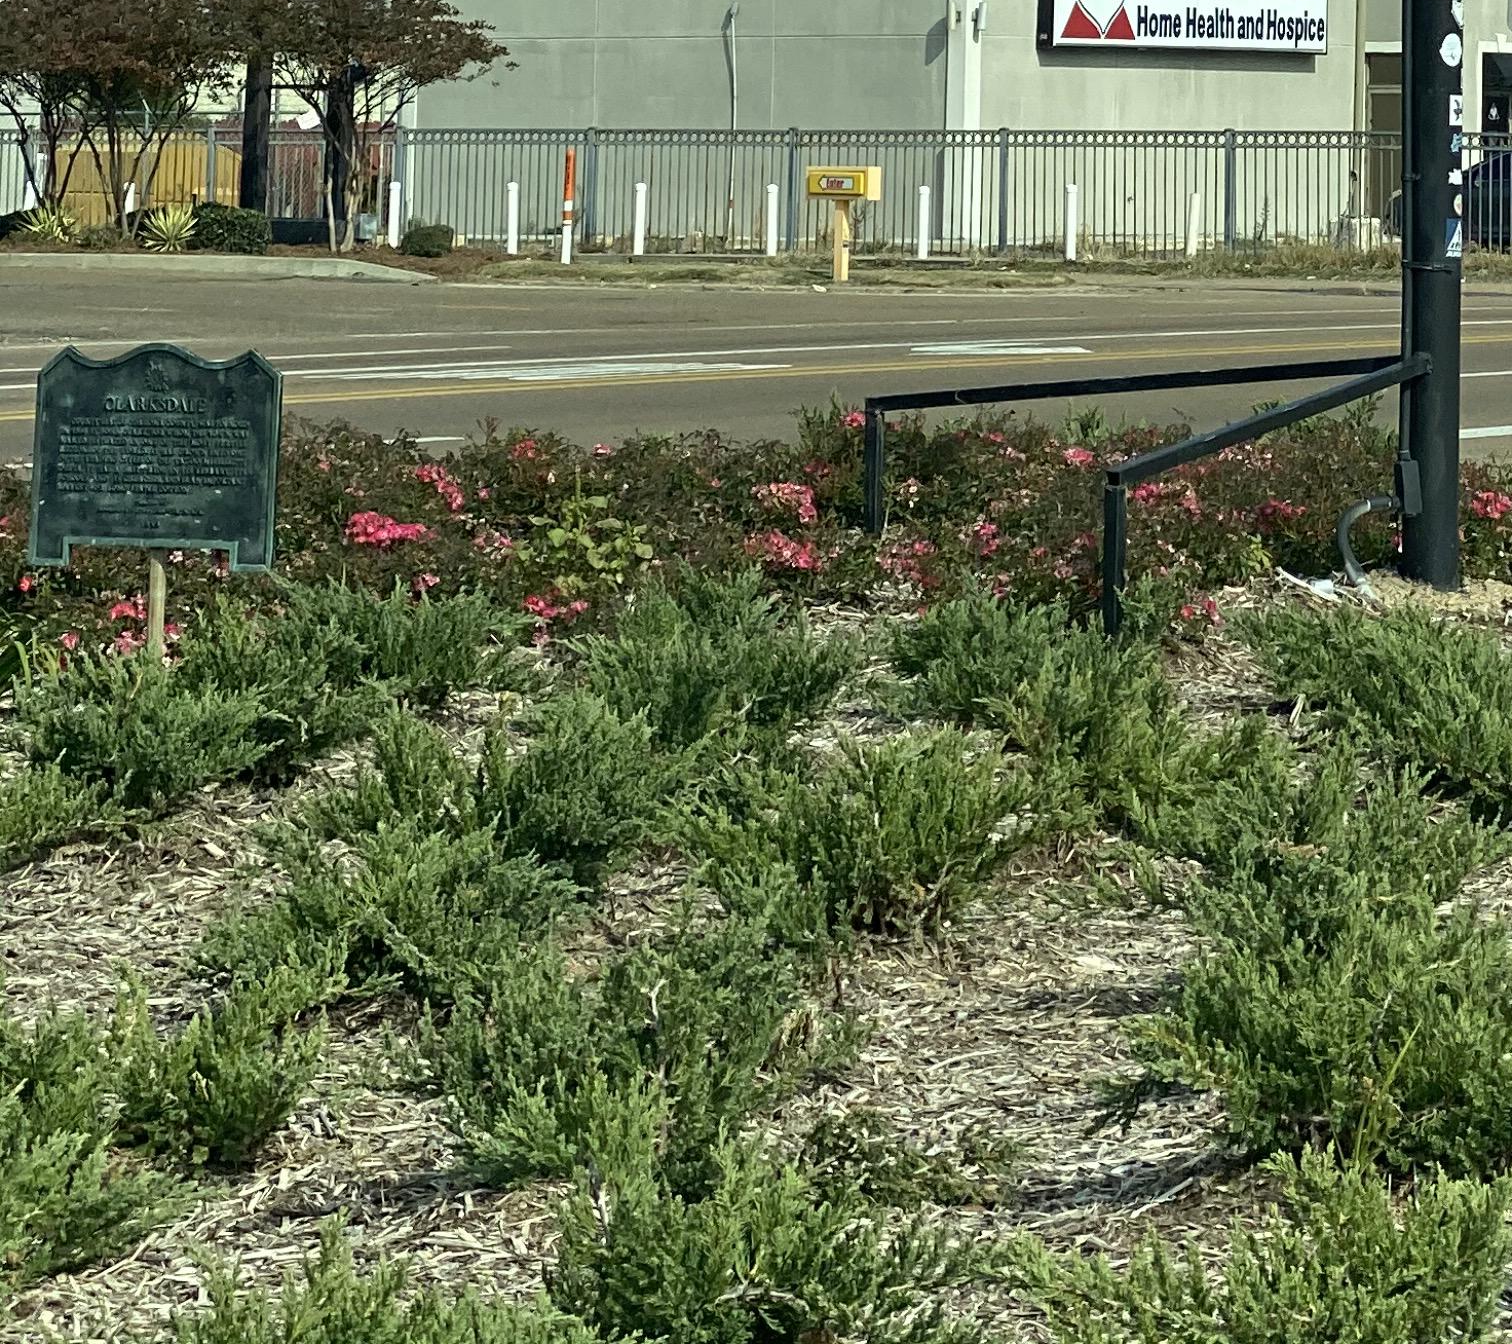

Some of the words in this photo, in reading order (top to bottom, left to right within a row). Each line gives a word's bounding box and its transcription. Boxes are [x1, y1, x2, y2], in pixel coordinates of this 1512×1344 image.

[1136, 5, 1181, 38] Home
[1186, 7, 1234, 40] Health
[1237, 11, 1264, 40] and
[1267, 9, 1325, 48] Hospice
